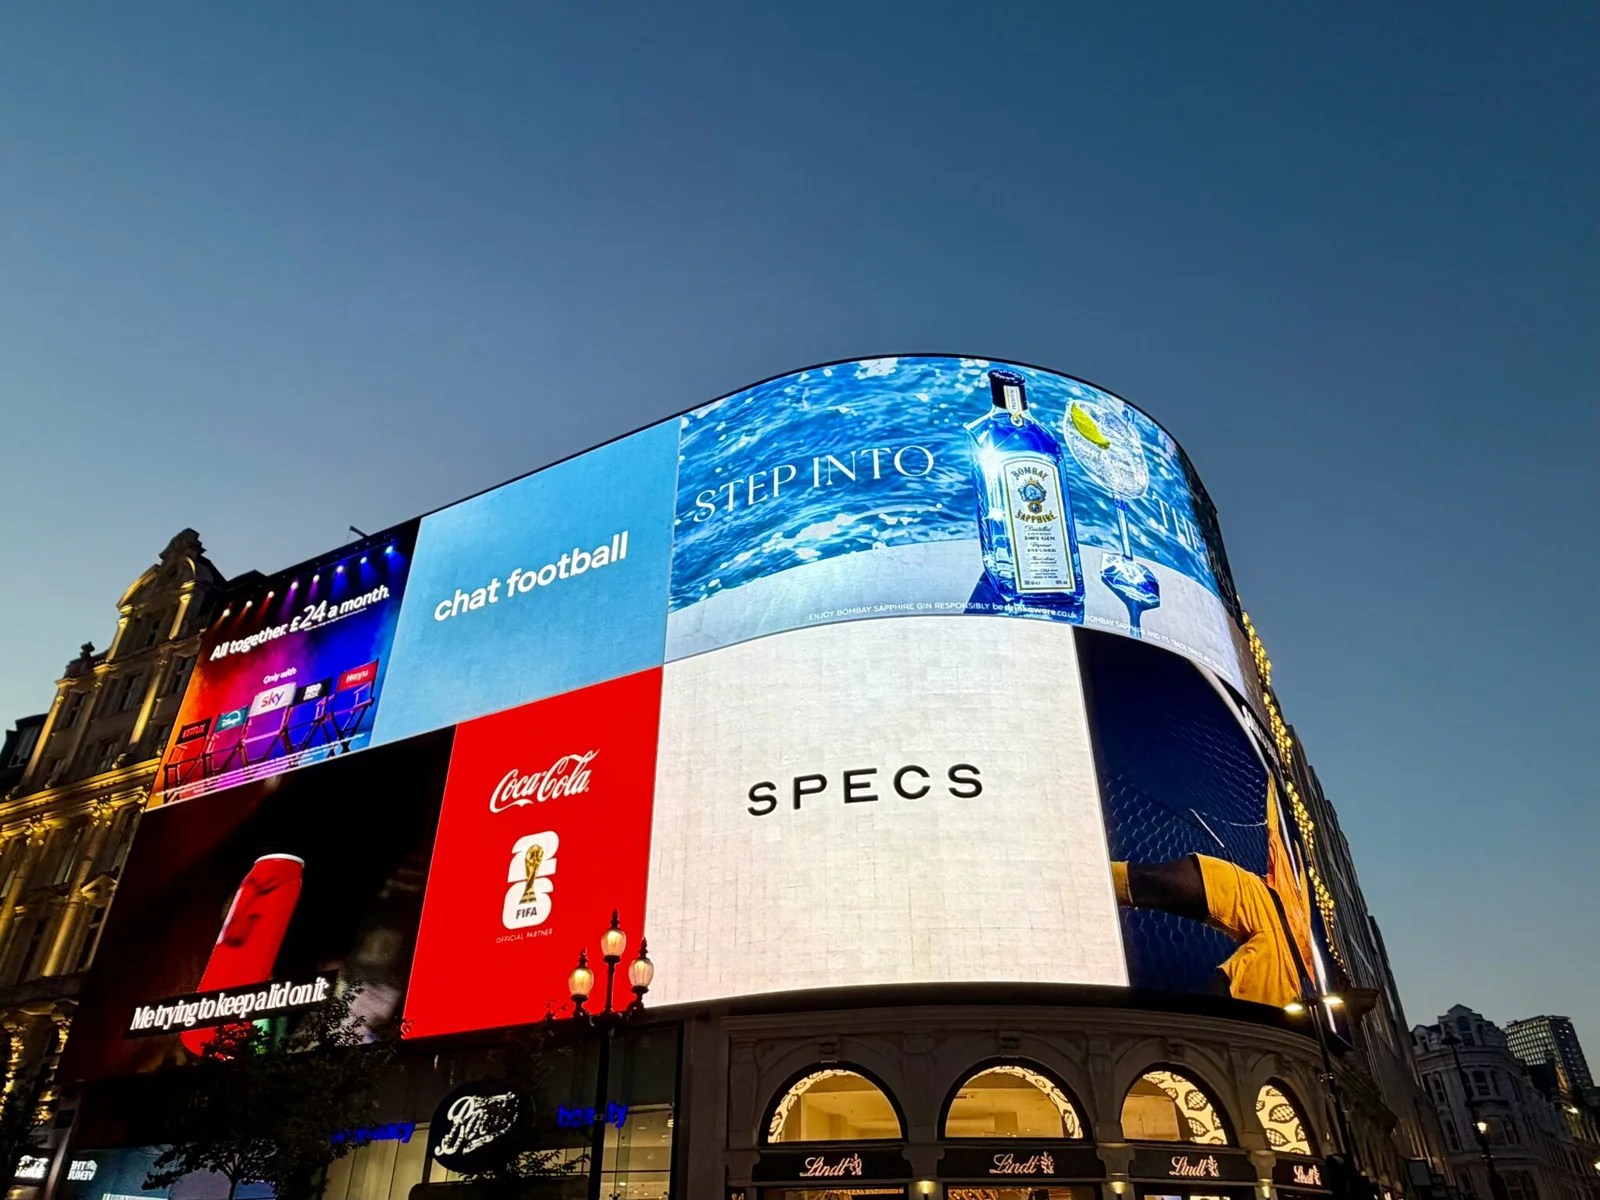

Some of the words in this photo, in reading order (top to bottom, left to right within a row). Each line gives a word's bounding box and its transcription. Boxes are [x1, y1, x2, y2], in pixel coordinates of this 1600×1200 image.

[693, 464, 796, 522] STEP
[812, 445, 934, 489] INTO
[1011, 466, 1049, 481] BOMBAY
[1014, 508, 1058, 524] SAPPHIRE
[434, 577, 500, 621] chat
[506, 530, 629, 598] football
[209, 641, 230, 661] All
[289, 599, 328, 633] £24
[328, 607, 338, 618] a
[808, 611, 835, 620] ENJOY
[836, 605, 872, 617] BOMBAY
[874, 603, 914, 612] SAPPHIRE
[917, 602, 932, 610] GIN
[935, 602, 989, 610] RESPONSIBLY
[1085, 615, 1114, 626] BOMBAY
[1147, 630, 1161, 641] AND
[263, 673, 280, 685] Only
[281, 667, 297, 679] with
[260, 690, 286, 709] sky
[489, 748, 600, 813] Coca-Cola
[747, 763, 983, 816] SPECS
[515, 906, 537, 919] FIFA
[496, 933, 524, 943] OFFICIAL
[526, 928, 553, 938] PARTNER
[130, 1007, 154, 1030] Me
[154, 1000, 197, 1030] trying
[198, 998, 215, 1020] to
[215, 993, 251, 1018] keep
[251, 994, 264, 1011] a
[264, 981, 290, 1011] lid
[289, 984, 311, 1005] on
[557, 1100, 629, 1129] beaty
[799, 1156, 849, 1177] Lindt
[988, 1153, 1040, 1174] Lindt
[1168, 1155, 1208, 1178] Lindt
[1292, 1165, 1315, 1184] Lindt
